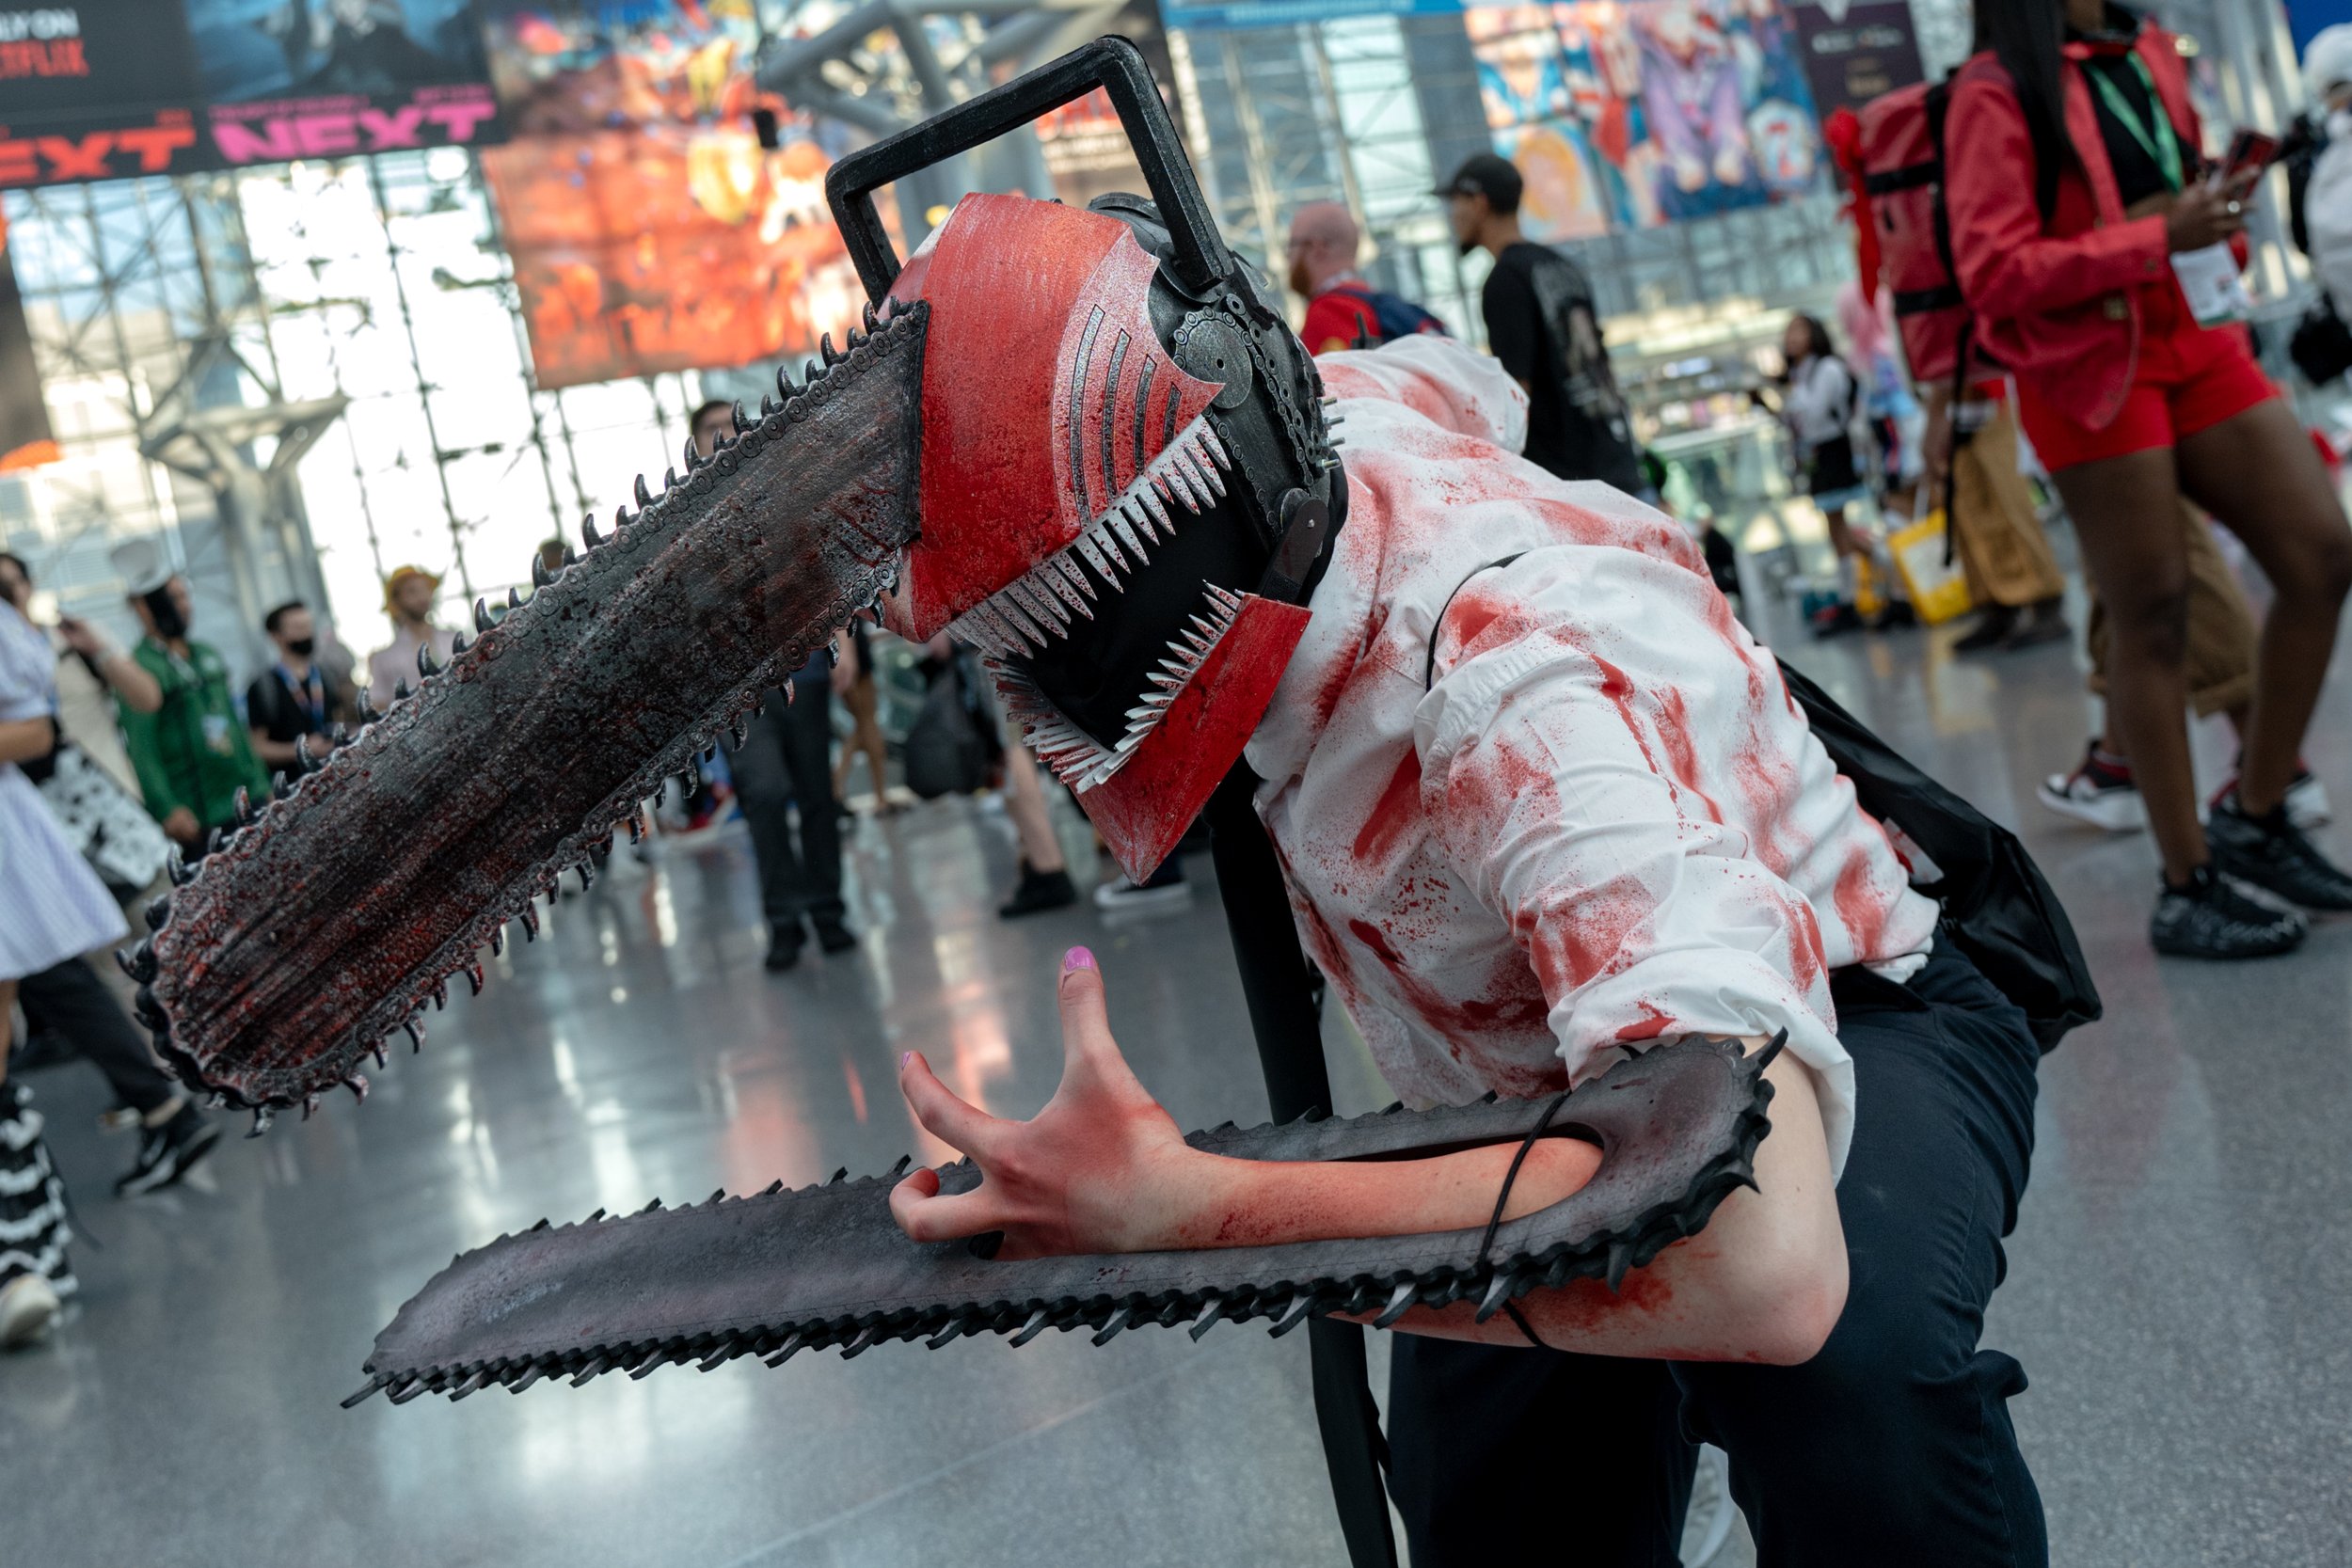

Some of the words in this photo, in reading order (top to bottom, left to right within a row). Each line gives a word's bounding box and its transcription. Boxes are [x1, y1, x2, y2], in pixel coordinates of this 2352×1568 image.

[0, 11, 29, 40] LY
[31, 9, 79, 39] ON
[212, 102, 495, 163] NEXT
